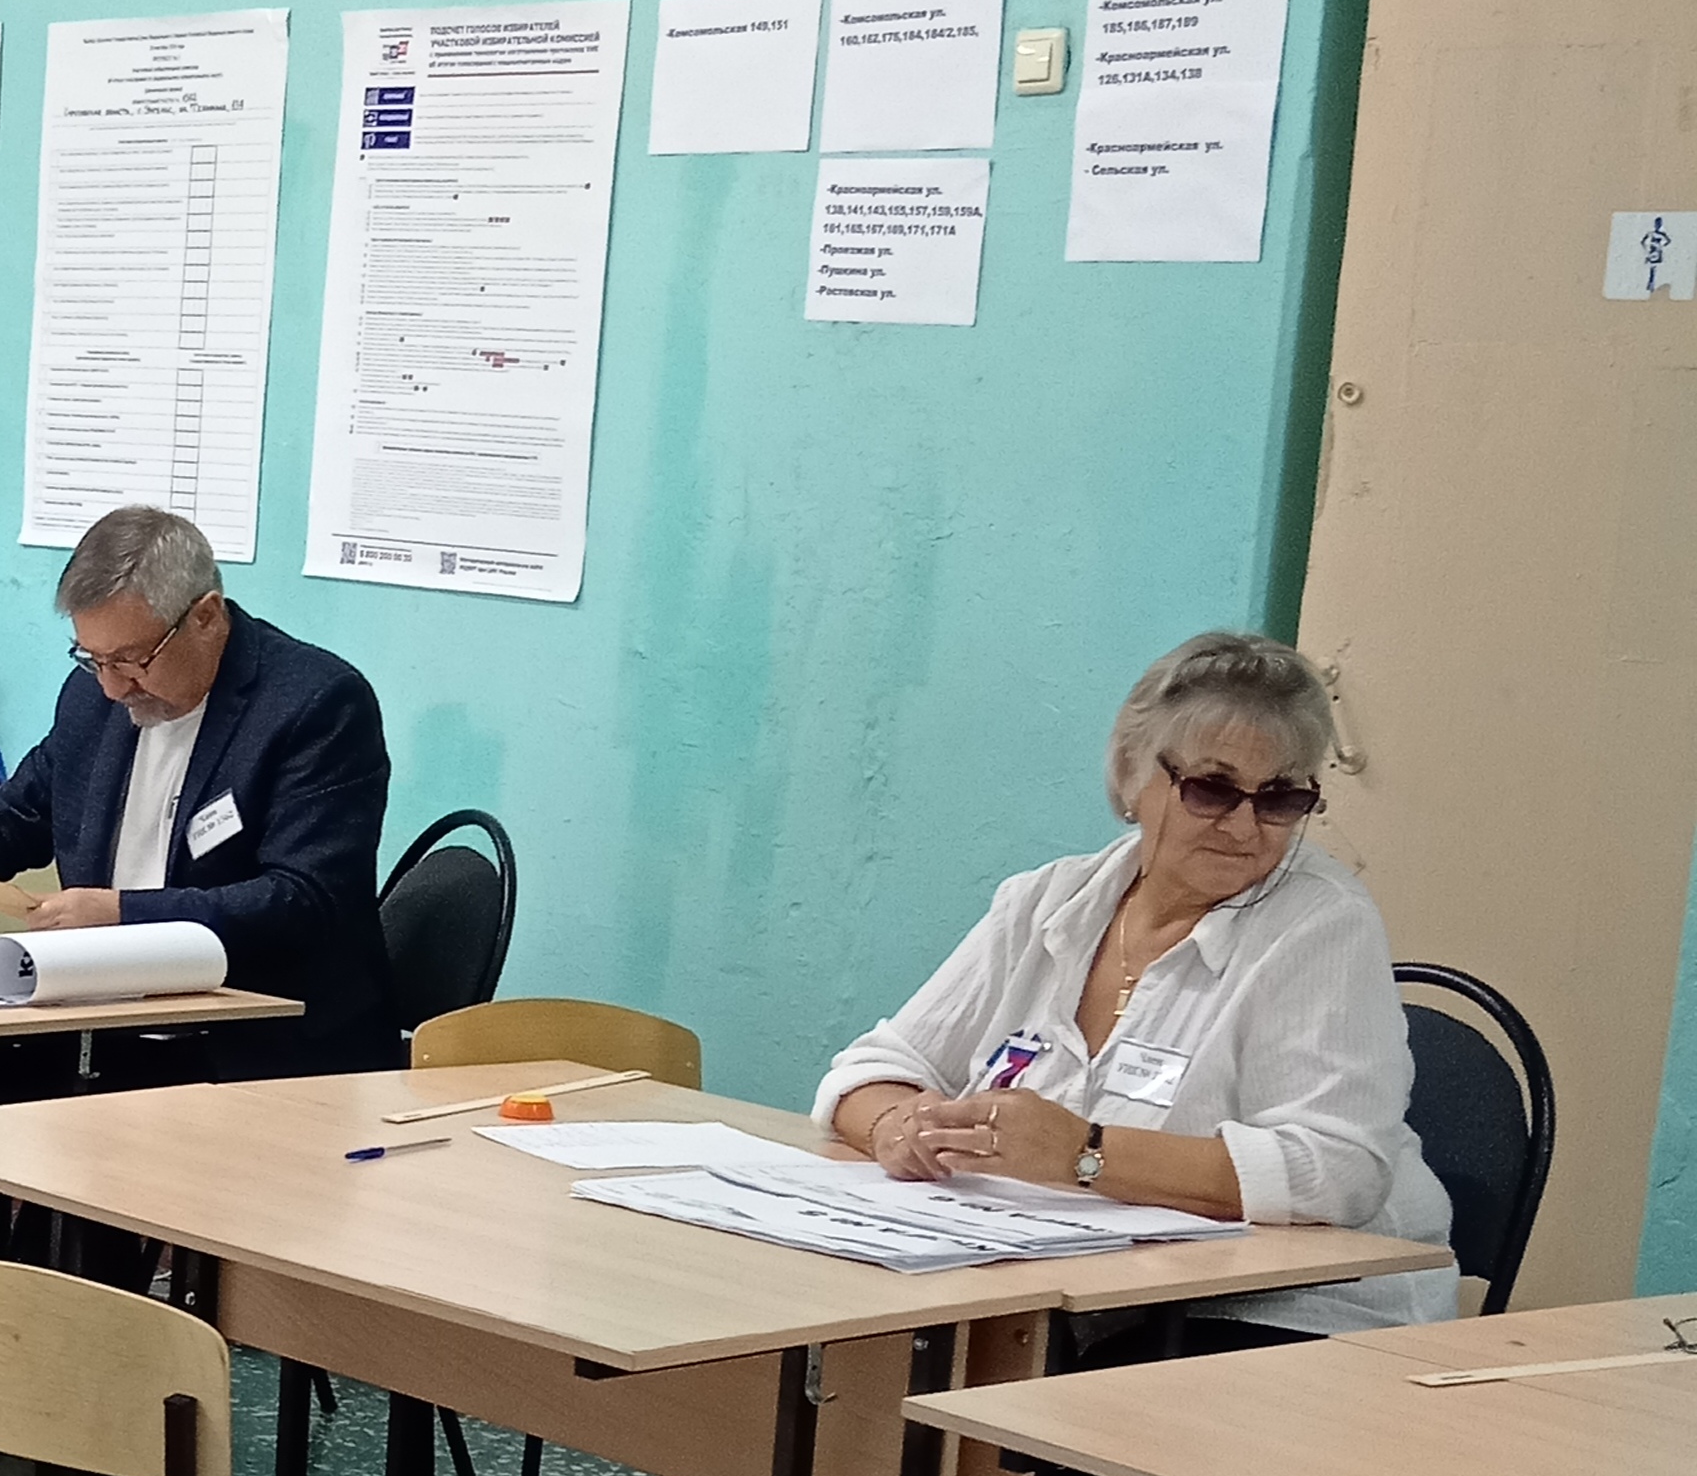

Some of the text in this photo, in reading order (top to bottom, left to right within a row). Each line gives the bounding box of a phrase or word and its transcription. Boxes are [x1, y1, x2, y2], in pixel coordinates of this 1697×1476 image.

[929, 8, 947, 21] ул.
[1212, 45, 1231, 58] ул.
[1205, 140, 1224, 153] ул.
[1151, 165, 1170, 177] ул.
[925, 186, 943, 197] ул.
[877, 247, 894, 258] ул.
[869, 267, 887, 278] ул.
[879, 289, 897, 300] ул.
